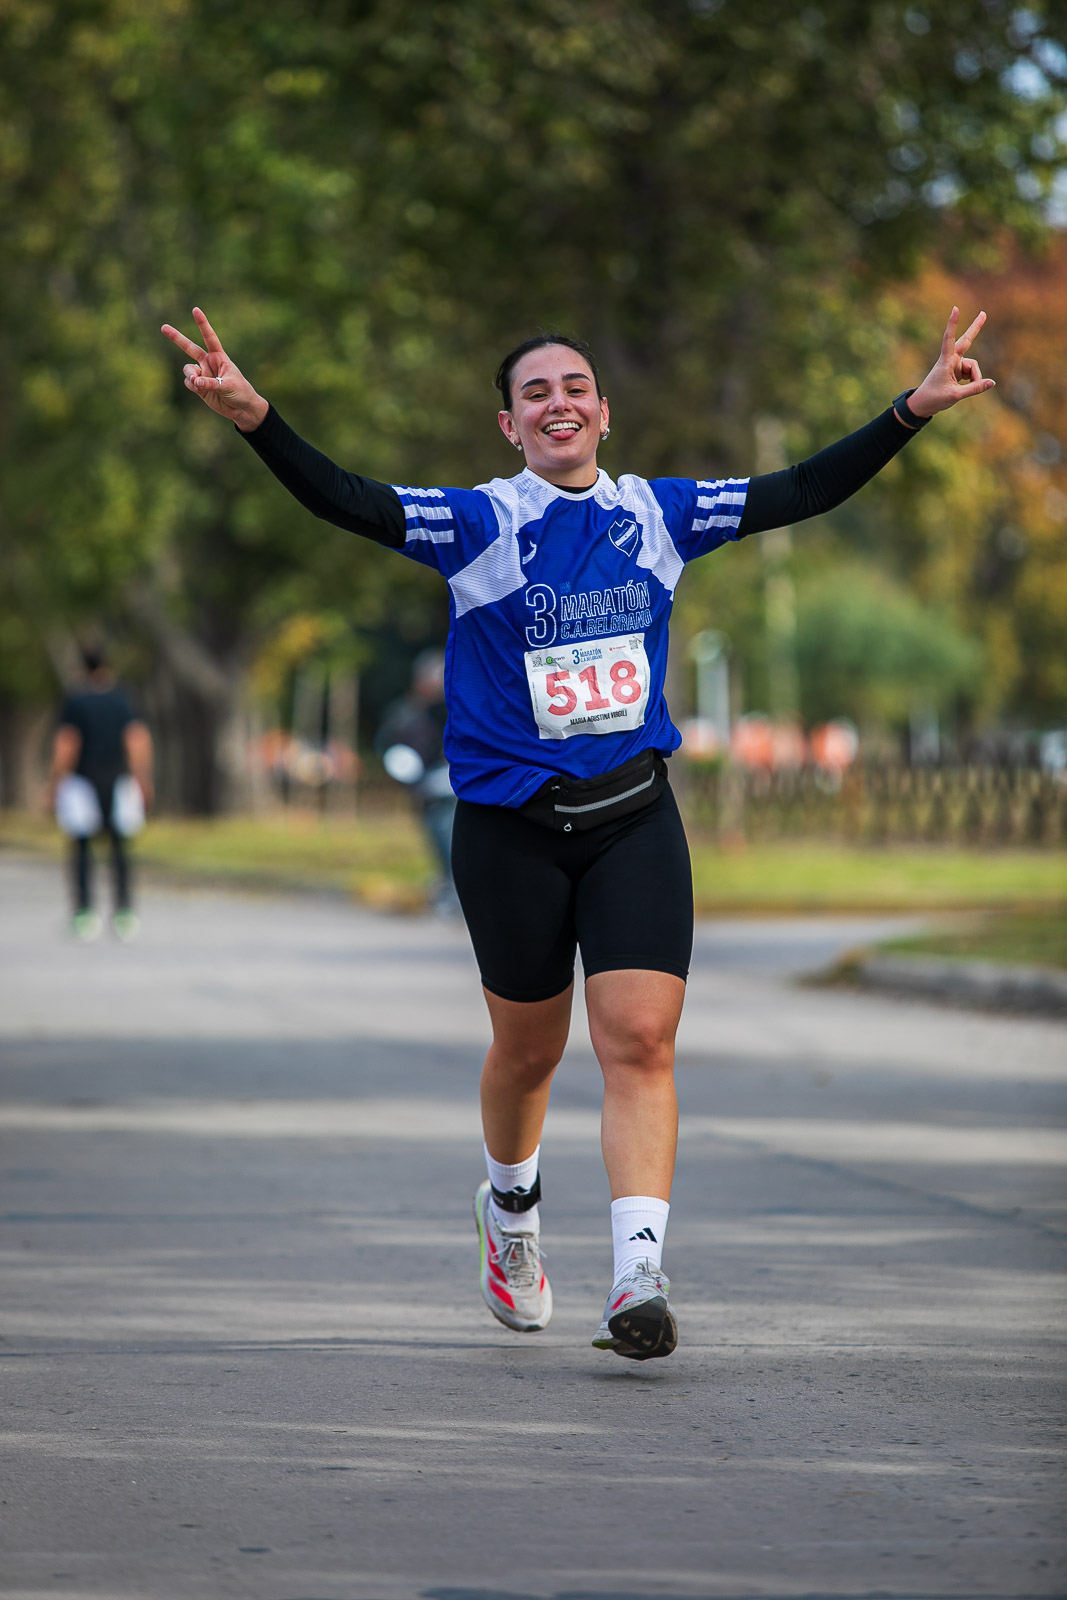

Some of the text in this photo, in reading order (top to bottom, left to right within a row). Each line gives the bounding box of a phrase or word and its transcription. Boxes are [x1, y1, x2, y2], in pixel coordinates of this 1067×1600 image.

[525, 579, 651, 647] 3 MARATÓN
[572, 649, 581, 664] 3
[546, 661, 641, 715] 518
